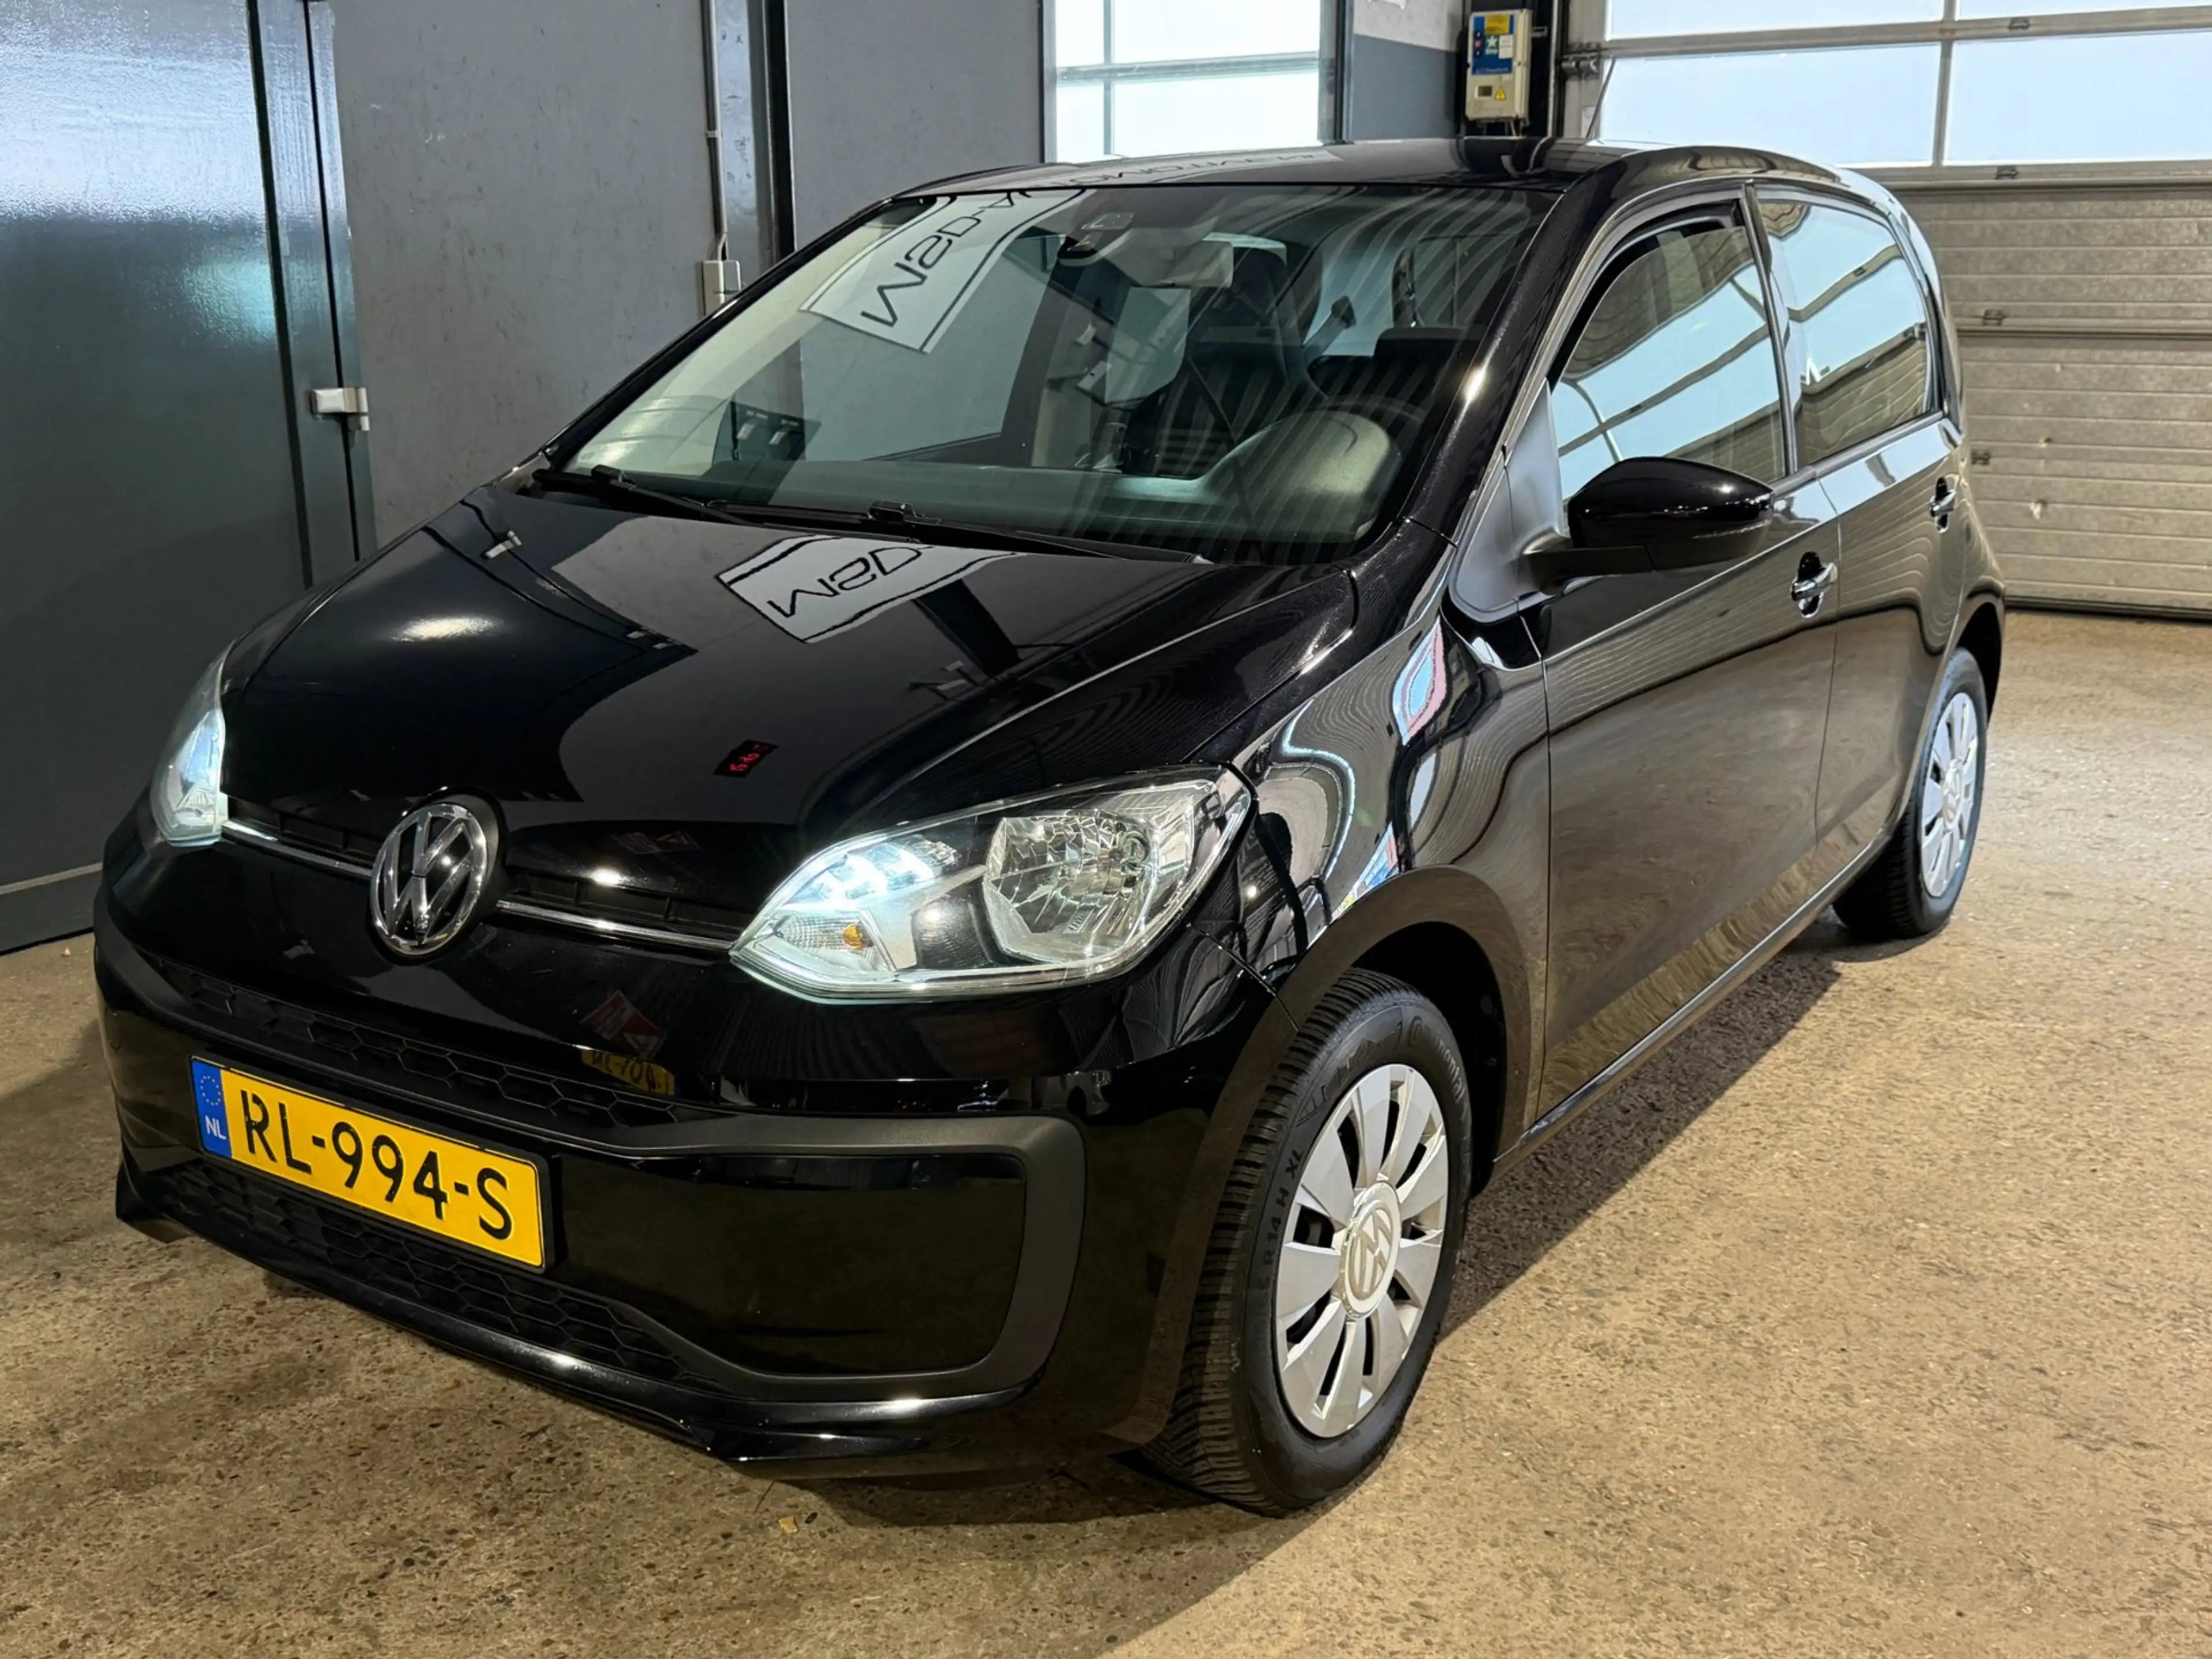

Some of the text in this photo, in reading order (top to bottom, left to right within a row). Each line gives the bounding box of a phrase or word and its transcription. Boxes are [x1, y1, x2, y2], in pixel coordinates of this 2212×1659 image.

[373, 803, 487, 955] VW
[206, 1115, 227, 1141] NL
[240, 1088, 514, 1241] RL-994-S
[1276, 1187, 1289, 1208] H
[1285, 1150, 1302, 1179] XL
